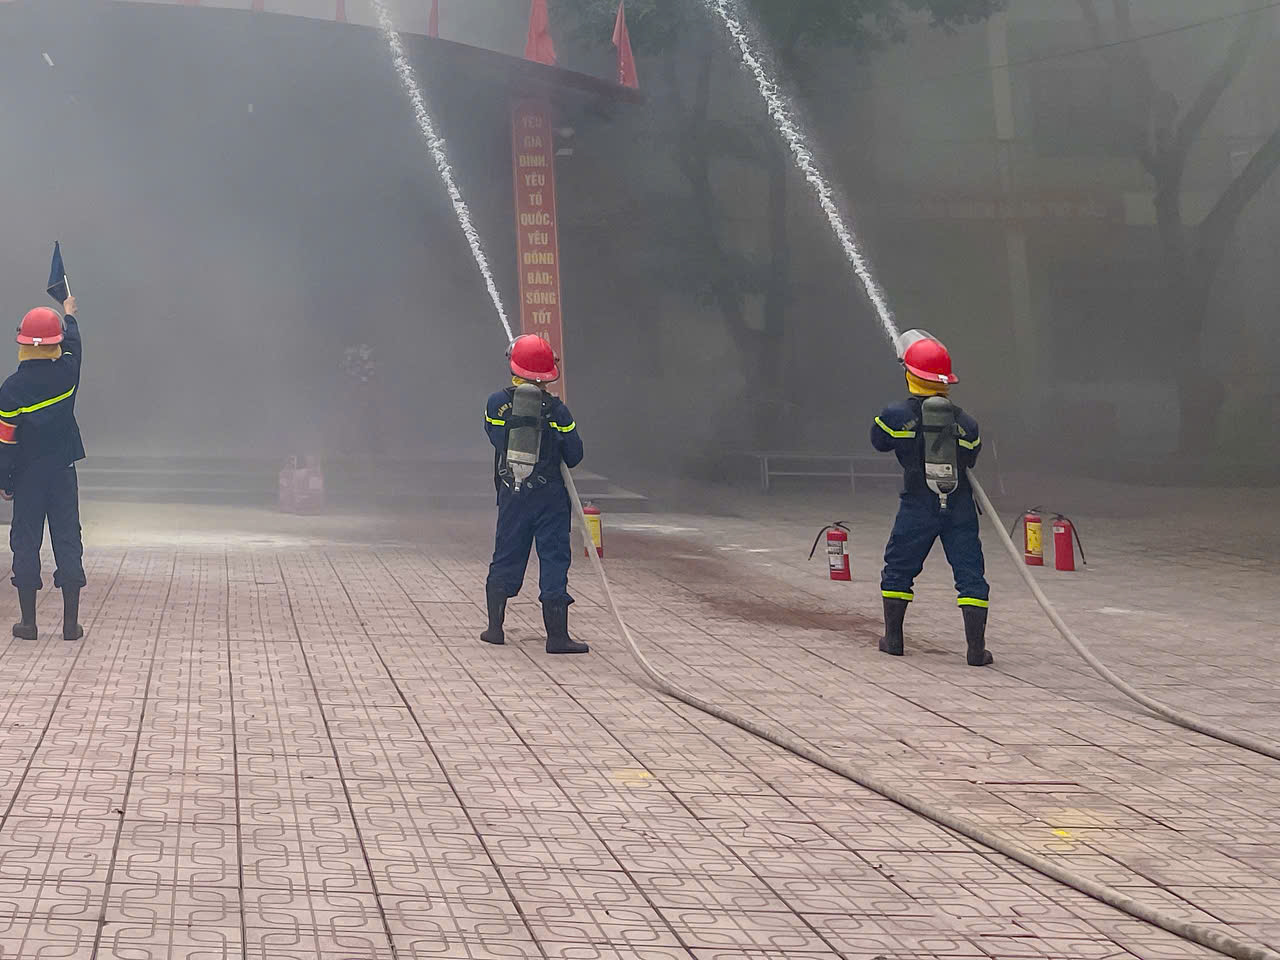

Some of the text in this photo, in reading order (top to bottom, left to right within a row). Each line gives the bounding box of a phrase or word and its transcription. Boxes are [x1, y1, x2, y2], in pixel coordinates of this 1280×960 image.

[524, 172, 545, 187] YÊU
[527, 230, 548, 245] YÊU
[531, 307, 552, 324] TỐT
